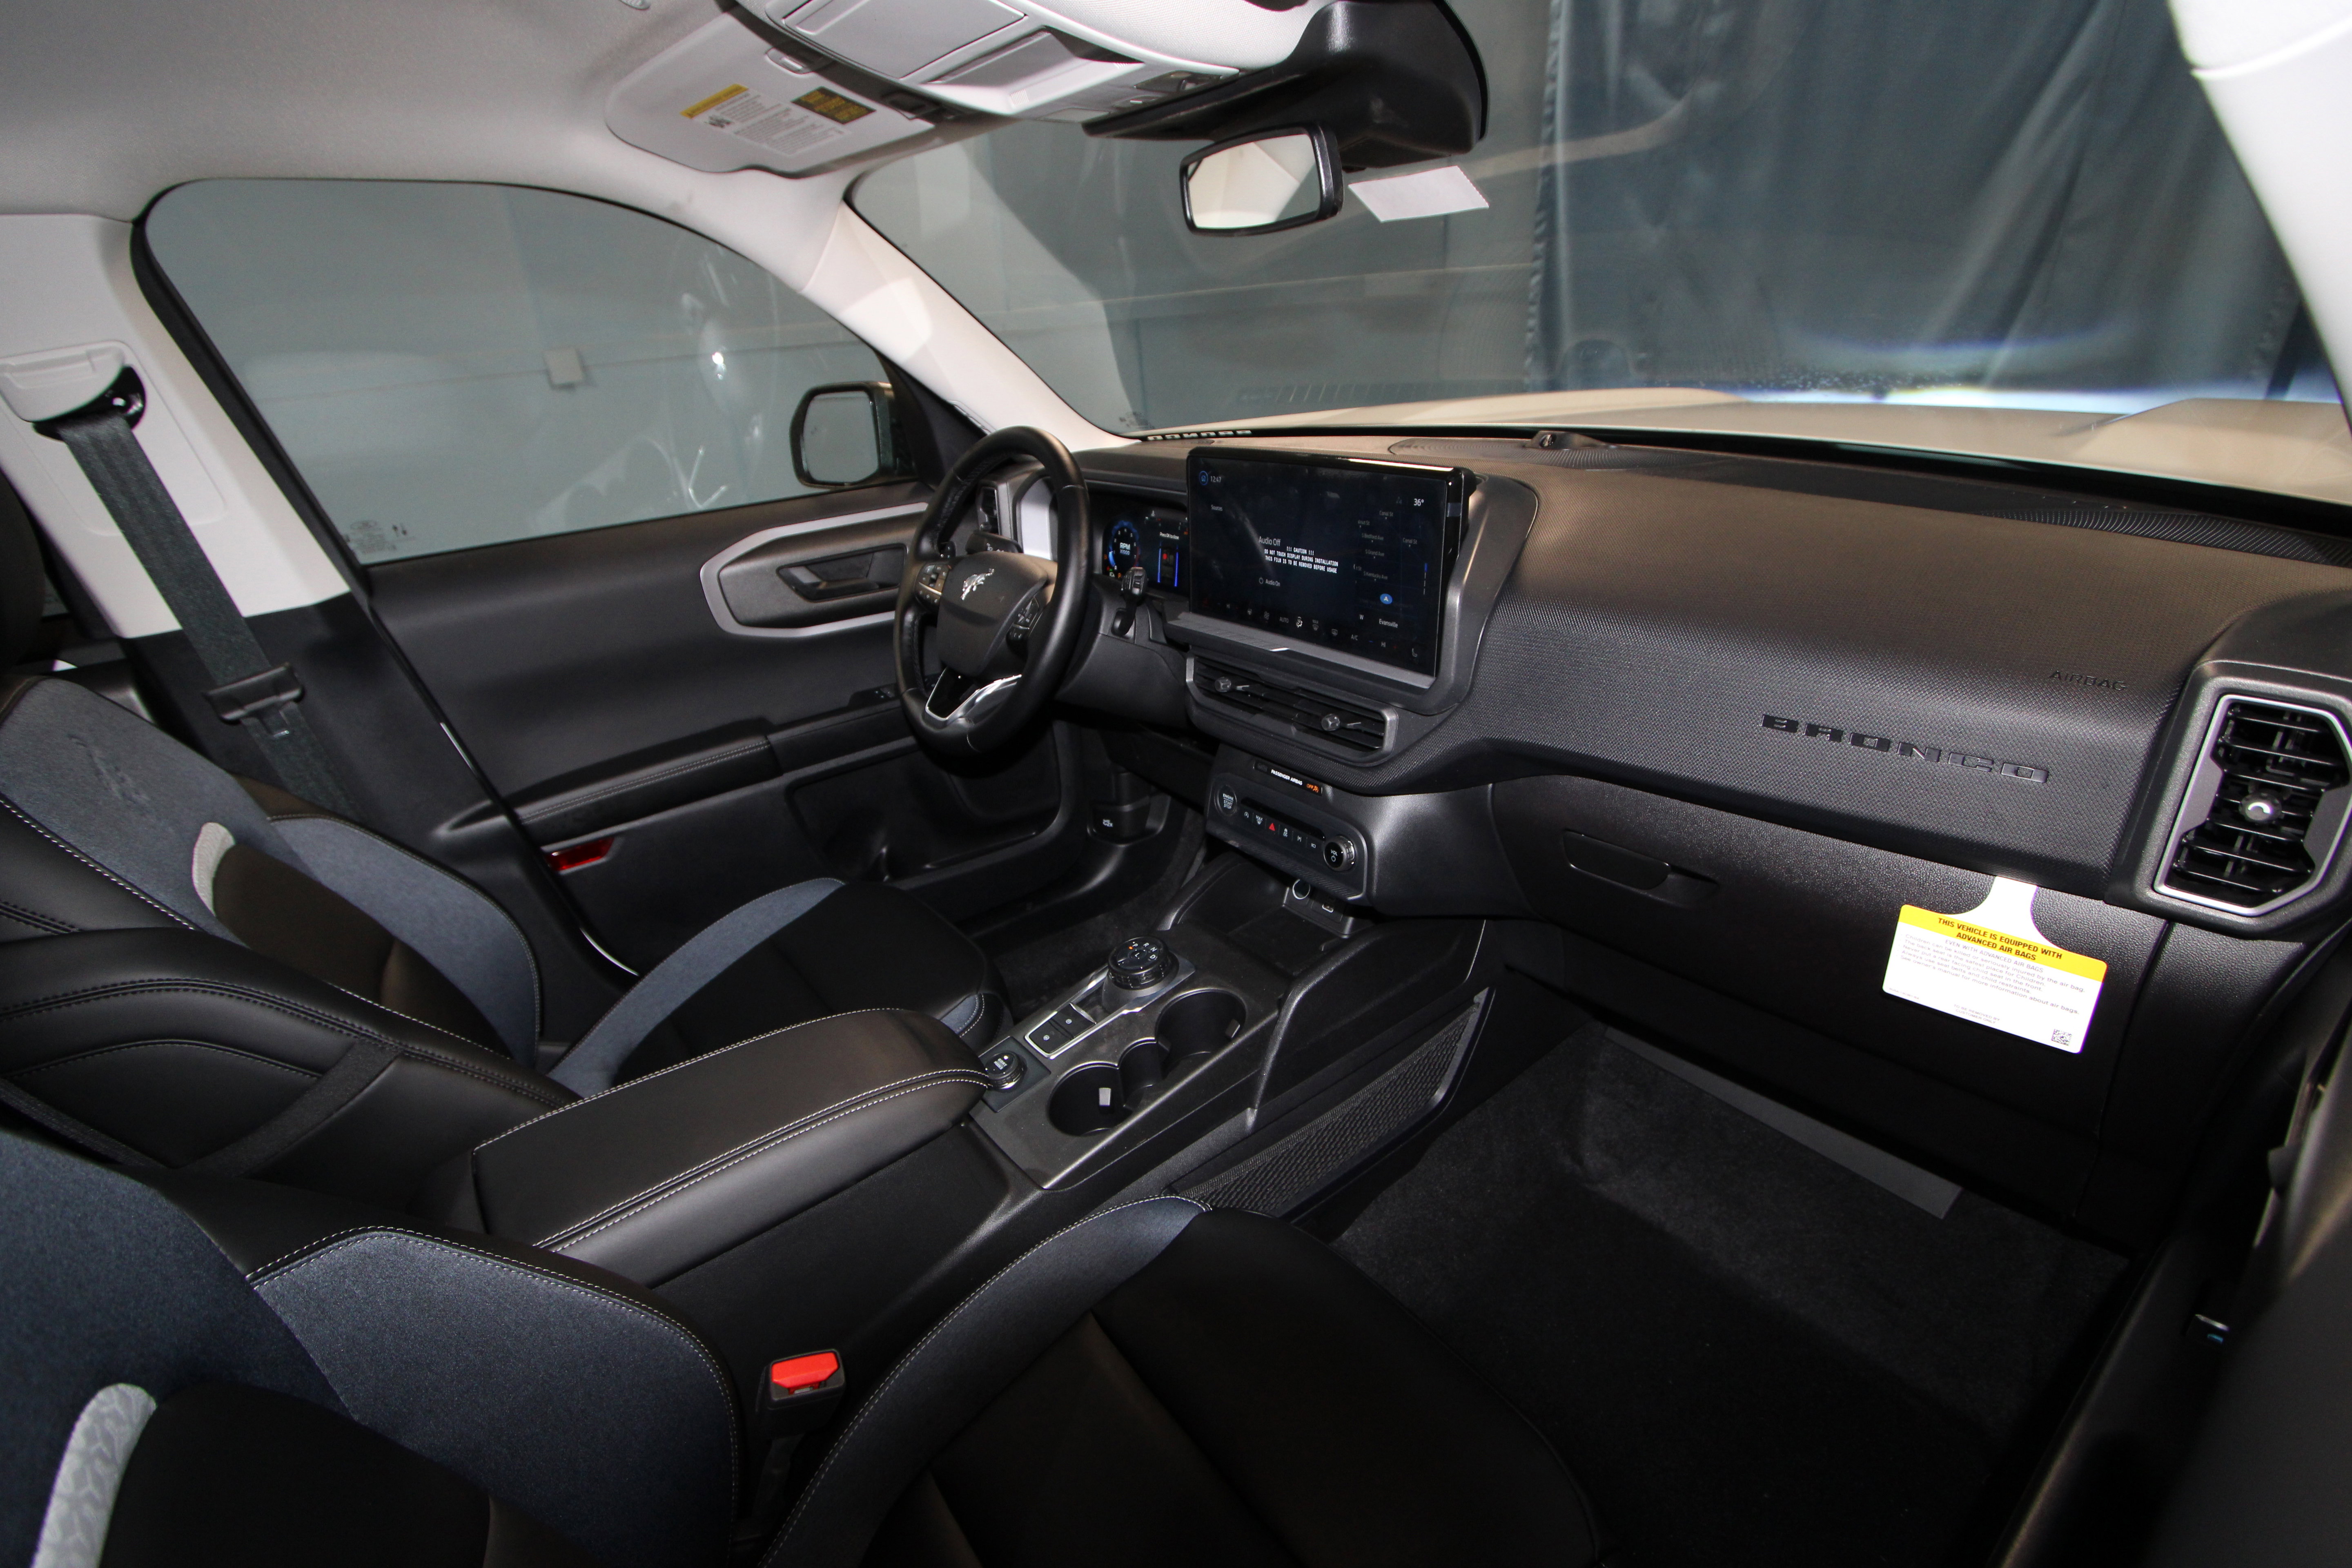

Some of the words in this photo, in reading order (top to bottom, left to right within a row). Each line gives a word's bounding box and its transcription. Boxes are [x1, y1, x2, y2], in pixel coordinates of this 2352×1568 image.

[1258, 536, 1272, 545] Audio
[1315, 557, 1339, 567] INSTALLATION
[1379, 618, 1398, 628] Evansville
[2048, 669, 2127, 691] AIRBAG
[1761, 714, 2049, 784] BRONCO
[1271, 769, 1290, 781] PASSENGER
[1290, 777, 1303, 786] AIRBAG
[1223, 793, 1234, 801] ENGINE
[1939, 918, 1954, 927] THIS
[1958, 924, 1987, 937] VEHICLE
[2000, 936, 2038, 952] EQUIPPED
[2041, 949, 2062, 959] WITH
[1956, 933, 1997, 948] ADVANCED
[2015, 950, 2036, 960] BAGS
[1902, 950, 1922, 960] Always
[1903, 944, 1920, 953] Never
[1952, 960, 1971, 970] facing
[1905, 934, 1930, 944] Children
[1954, 949, 1971, 958] killed
[1980, 958, 2010, 970] seriously
[2012, 967, 2035, 977] injured
[1945, 939, 1960, 947] EVEN
[1979, 950, 2012, 963] ADVANCED
[2026, 964, 2043, 973] BAGS
[1965, 959, 1984, 967] safest
[1938, 968, 1960, 977] manual
[1990, 984, 2027, 998] information
[2029, 996, 2049, 1005] about
